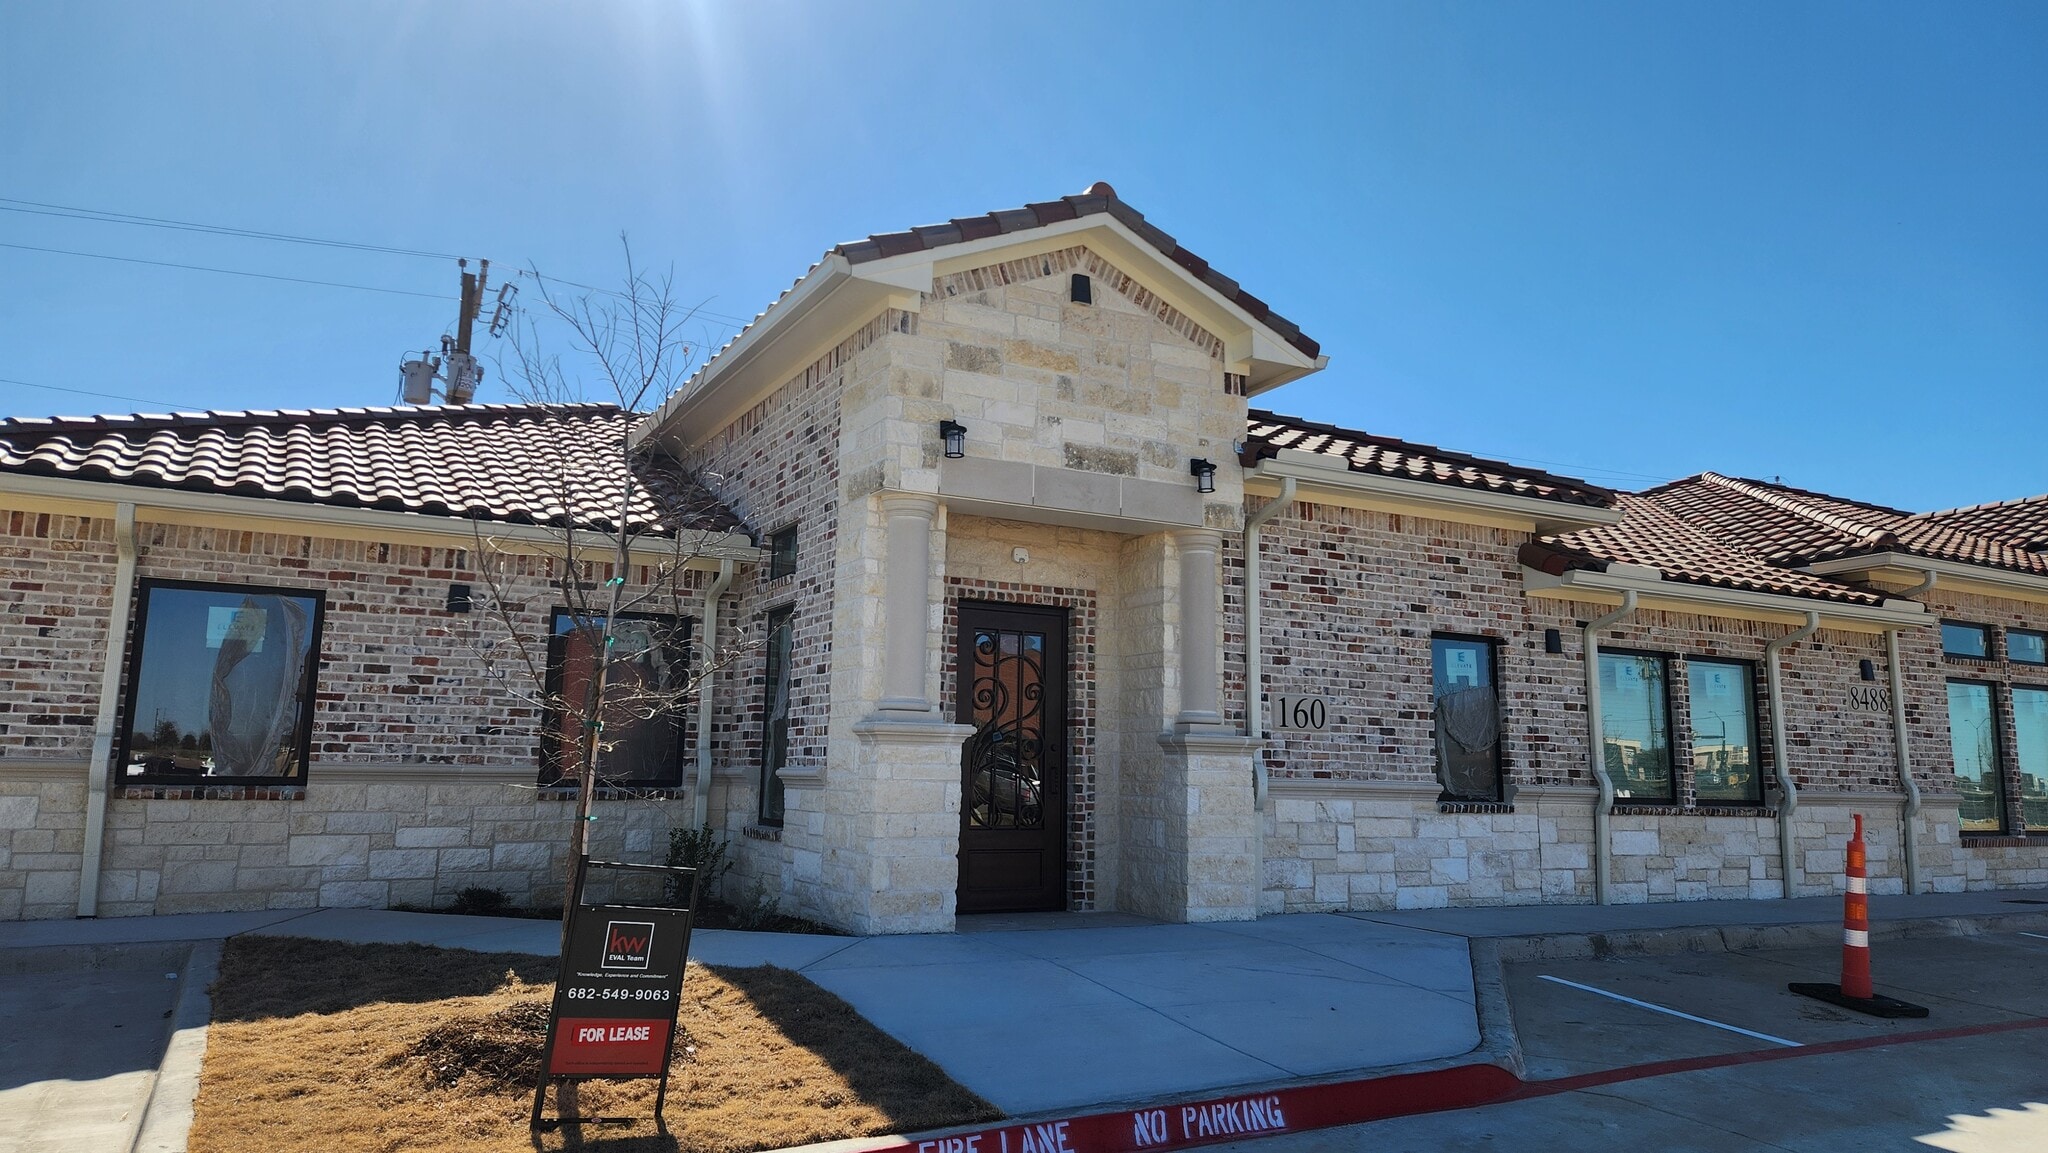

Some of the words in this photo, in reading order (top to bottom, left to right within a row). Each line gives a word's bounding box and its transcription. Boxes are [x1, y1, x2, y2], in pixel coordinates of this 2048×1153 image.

[1850, 686, 1888, 712] 8488
[1278, 696, 1326, 730] 160
[610, 927, 647, 953] kw
[627, 954, 645, 962] Team
[568, 987, 670, 1001] 682-549-9063
[579, 1027, 606, 1042] FOR
[609, 1026, 650, 1042] LEASE
[1134, 1109, 1168, 1147] NO
[1181, 1095, 1285, 1140] PARKING
